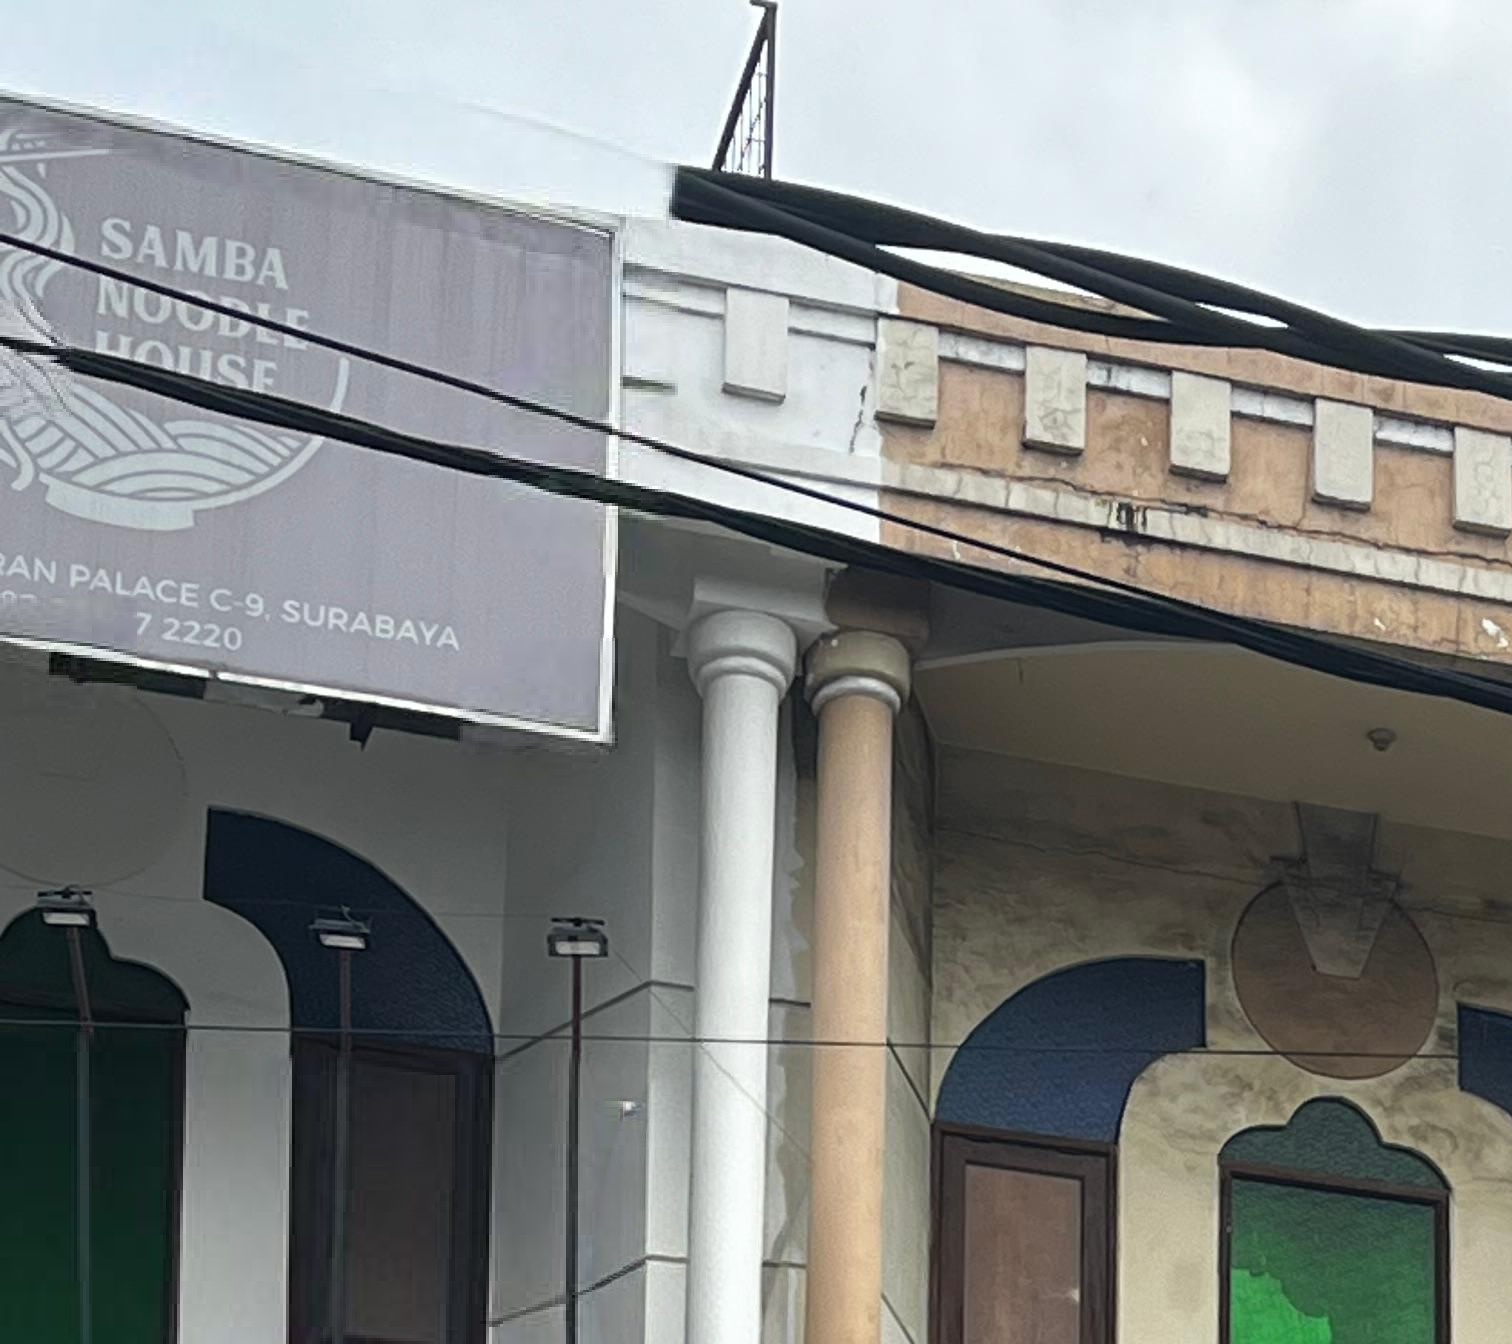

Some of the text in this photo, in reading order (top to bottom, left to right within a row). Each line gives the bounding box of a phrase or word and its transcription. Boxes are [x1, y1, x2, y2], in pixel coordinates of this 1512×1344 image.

[101, 217, 288, 290] SAMBA
[97, 272, 310, 350] NOODLE
[0, 552, 460, 651] AN PALACE C-9, SURABAYA
[162, 618, 243, 651] 2220
